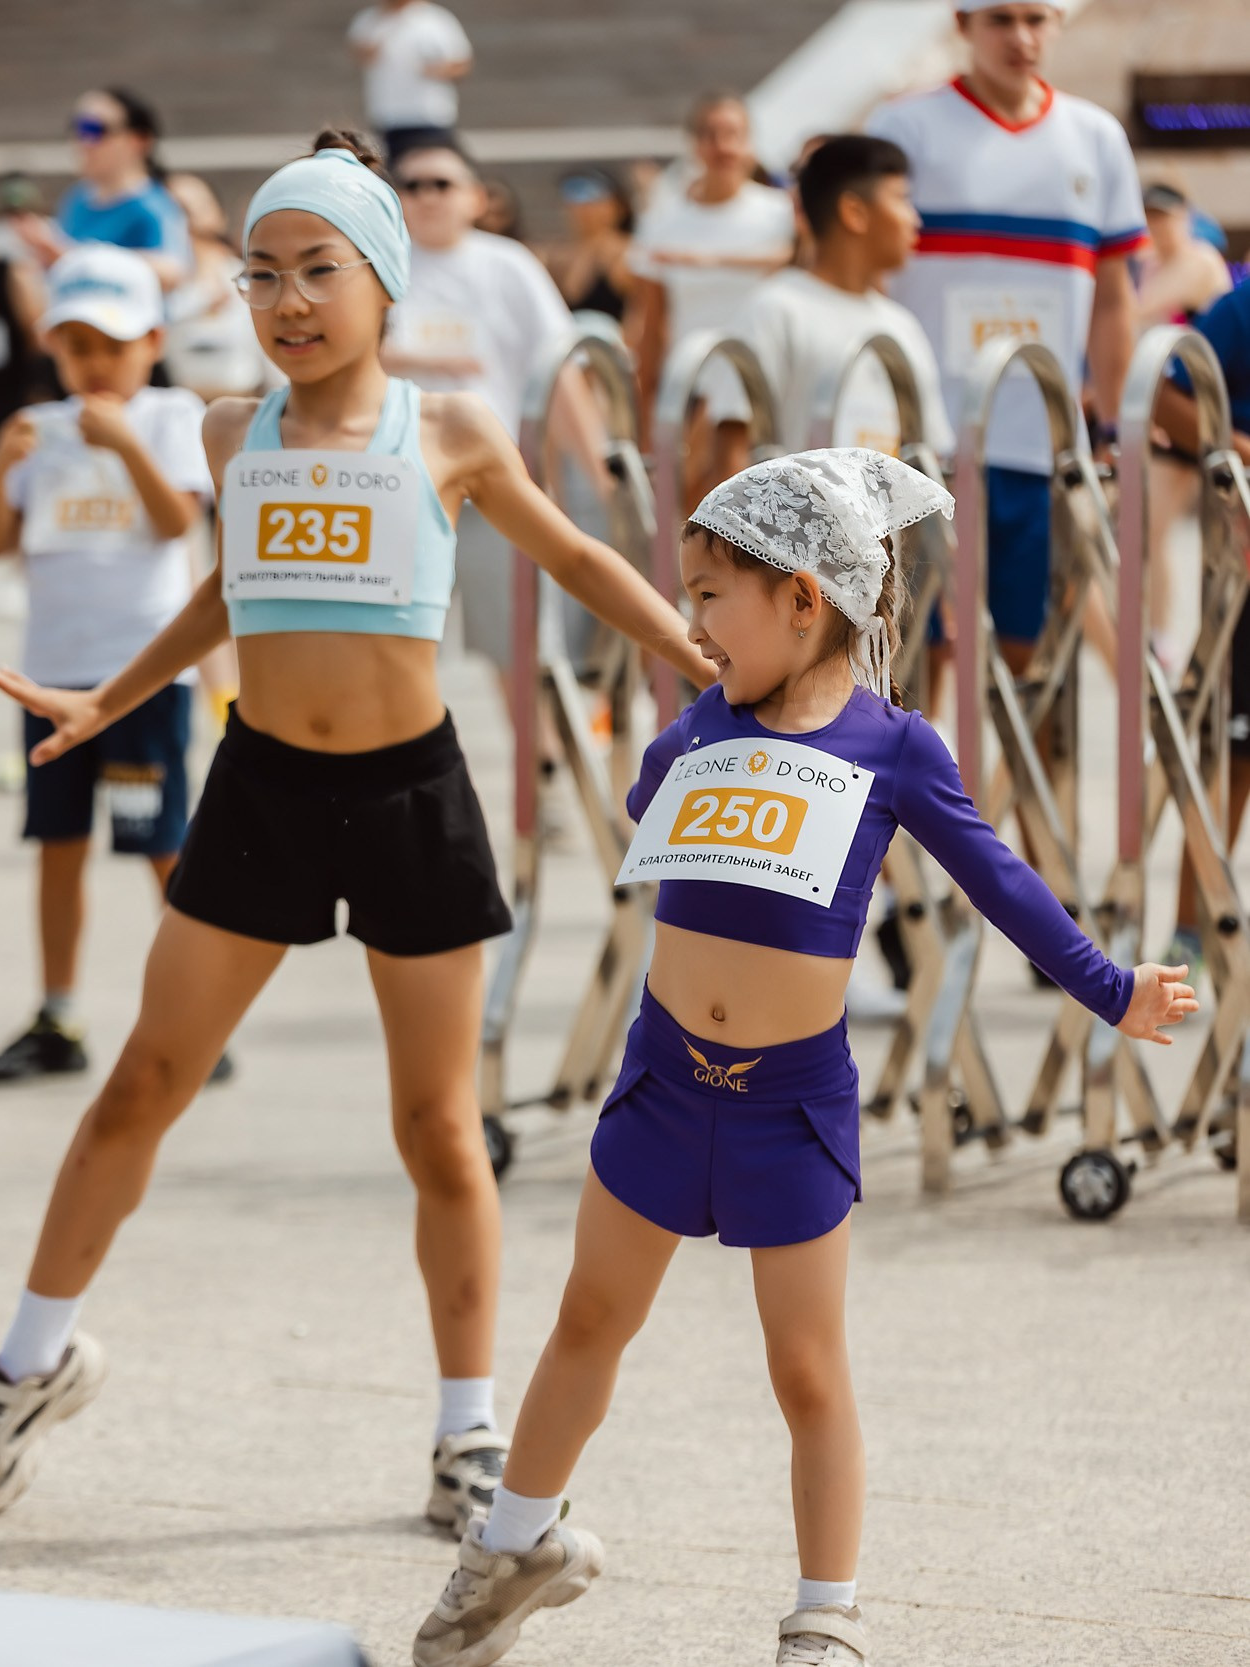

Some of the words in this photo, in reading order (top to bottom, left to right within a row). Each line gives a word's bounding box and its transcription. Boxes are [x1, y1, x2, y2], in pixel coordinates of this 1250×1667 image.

[239, 470, 299, 488] LEONE
[265, 509, 360, 557] 235
[675, 757, 738, 782] LEONE
[776, 761, 847, 793] D'ORO
[680, 795, 789, 843] 250
[639, 853, 772, 872] БЛАГОТВОРИТЕЛЬНЫЙ
[774, 864, 814, 882] ЗАБЕГ
[694, 1068, 748, 1092] GIONE
